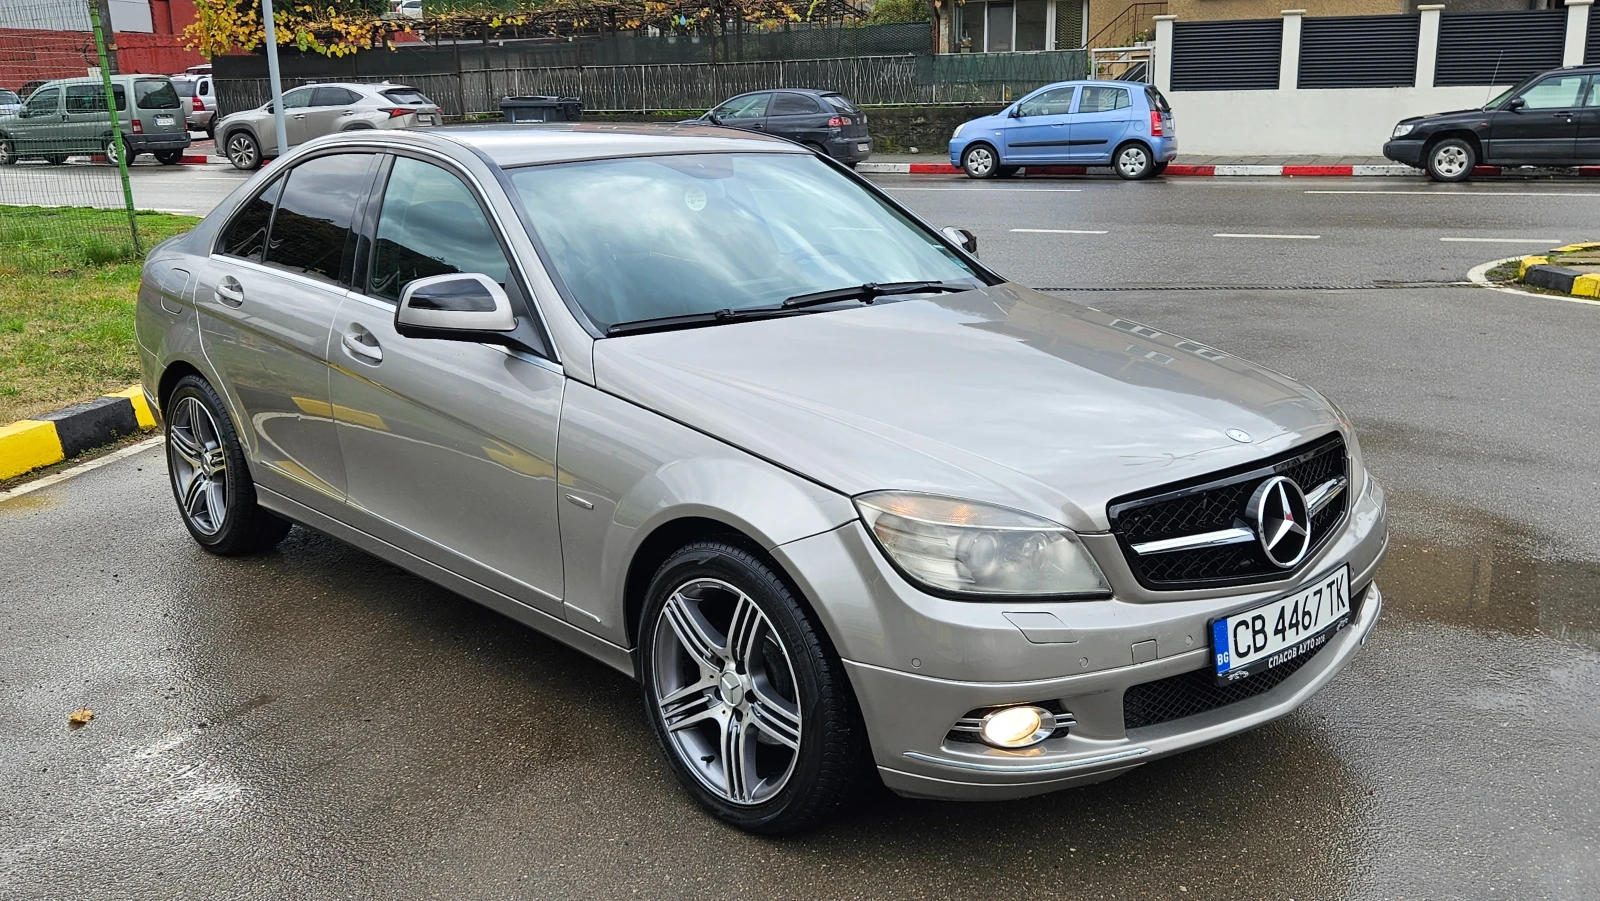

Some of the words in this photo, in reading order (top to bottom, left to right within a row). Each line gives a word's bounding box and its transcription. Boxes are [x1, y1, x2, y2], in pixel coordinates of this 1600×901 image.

[1233, 613, 1268, 659] CB
[1273, 588, 1323, 643] 4467
[1326, 573, 1346, 617] TK
[1217, 651, 1230, 666] BG
[1268, 647, 1298, 669] СПАСОВ
